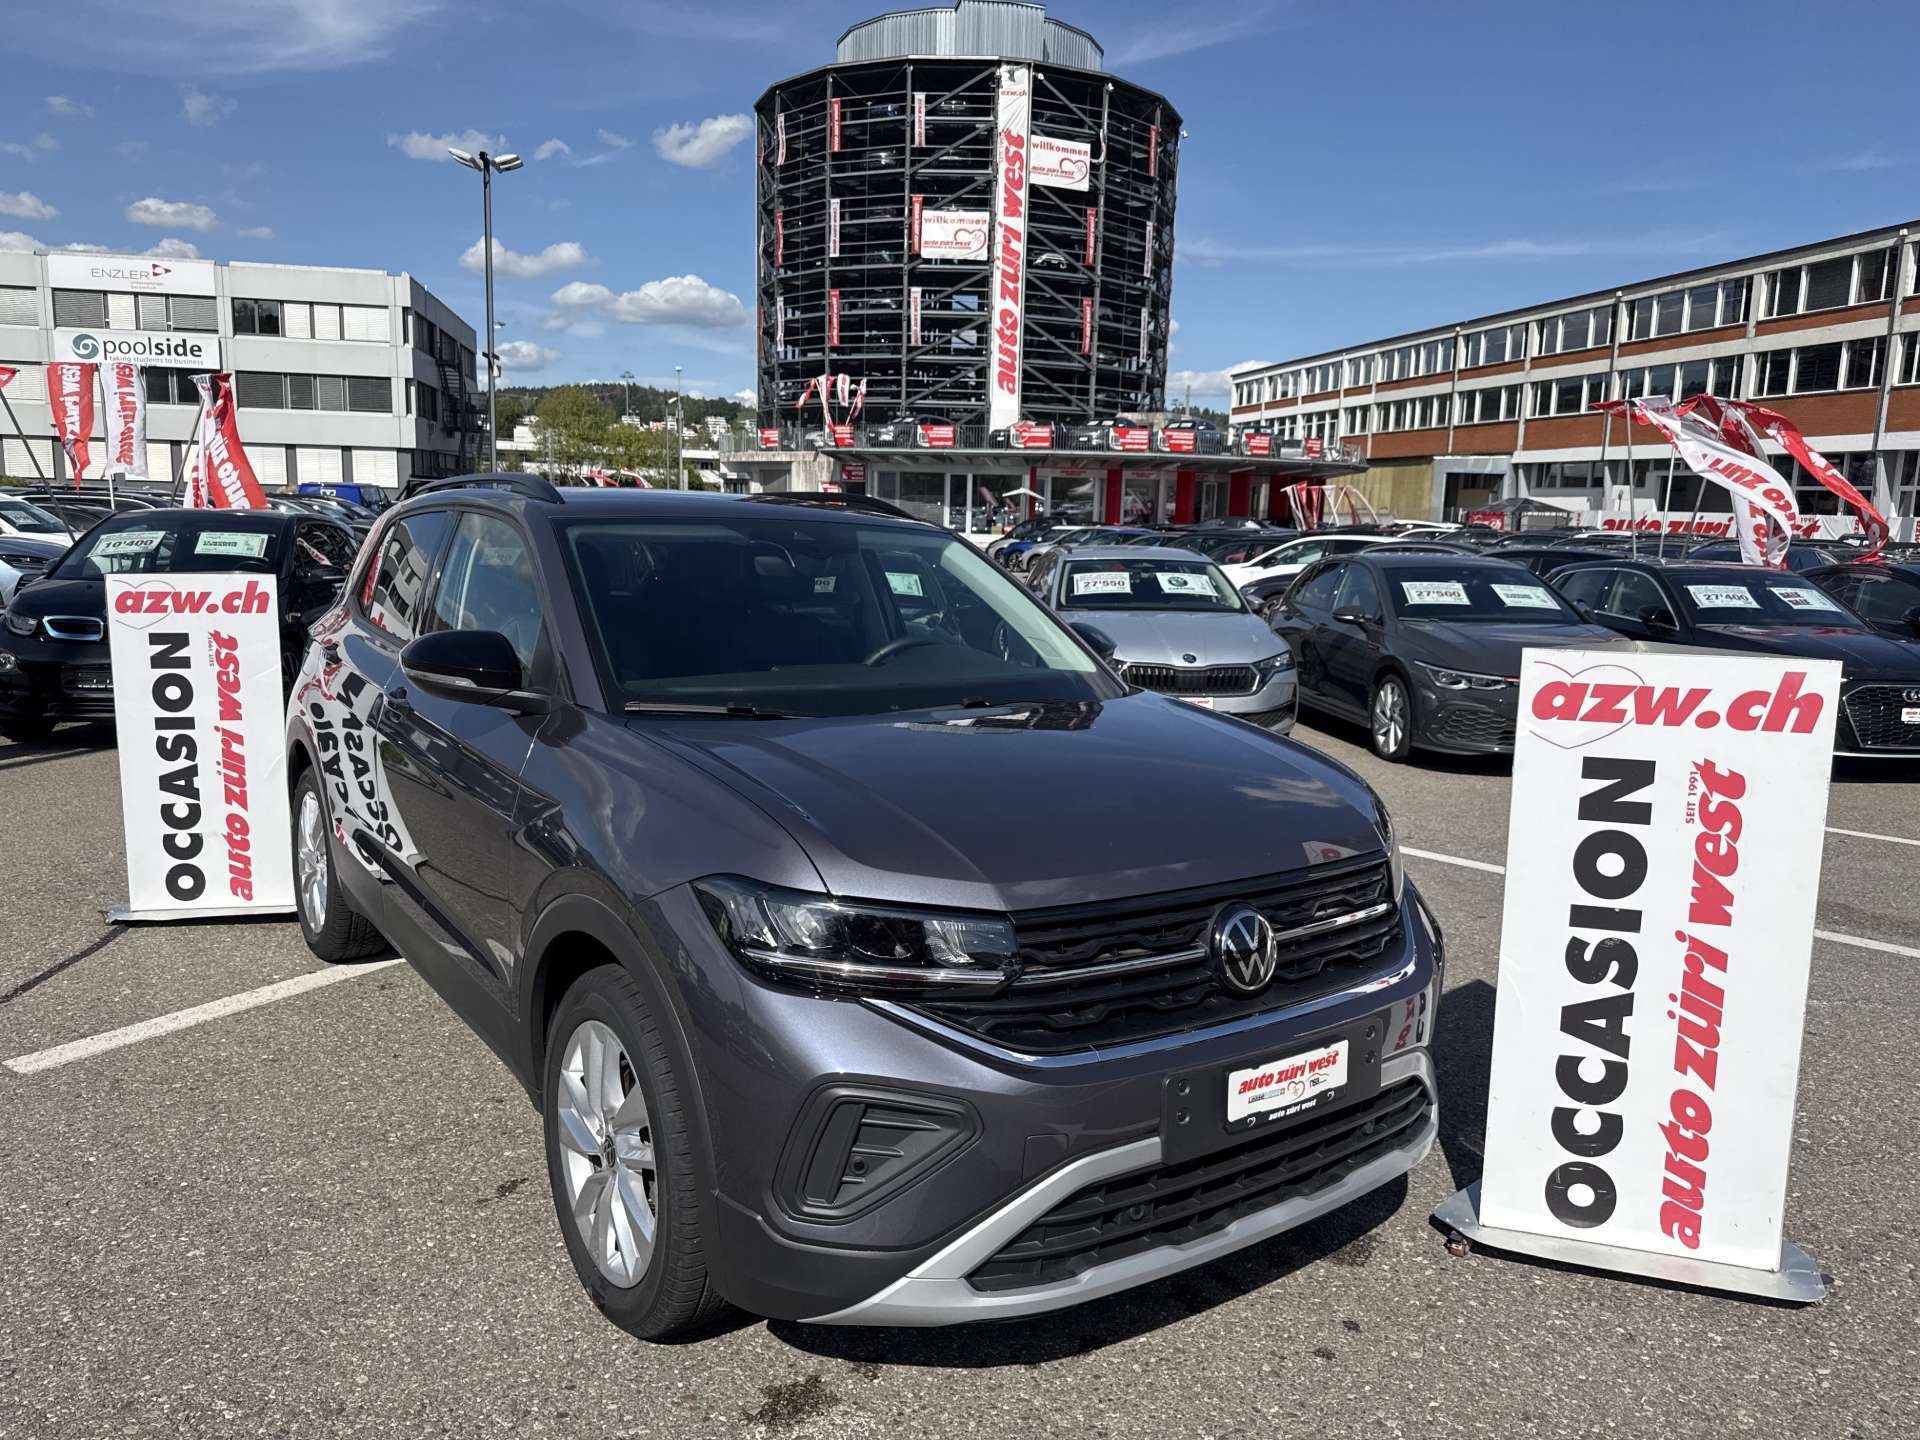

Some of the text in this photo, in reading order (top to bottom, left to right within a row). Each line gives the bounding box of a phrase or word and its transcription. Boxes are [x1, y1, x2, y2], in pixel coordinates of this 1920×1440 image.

[1031, 140, 1089, 156] willkommen
[924, 214, 987, 225] willkommen
[91, 268, 150, 280] ENZLER
[995, 128, 1025, 395] auto züri west
[103, 337, 203, 361] poolside
[174, 358, 204, 366] business
[104, 539, 154, 549] 10'400
[114, 580, 271, 615] azw.ch
[1083, 580, 1126, 588] 27'550
[1415, 590, 1461, 599] 27'500
[1531, 671, 1825, 735] azw.ch
[148, 632, 206, 902] OCCASION
[208, 629, 254, 902] auto züri west
[1685, 771, 1699, 825] SEIT 1991
[1545, 756, 1657, 1230] OCCASION
[1658, 757, 1747, 1251] auto züri west
[1238, 1050, 1340, 1095] auto züri west
[1268, 1109, 1285, 1121] auto
